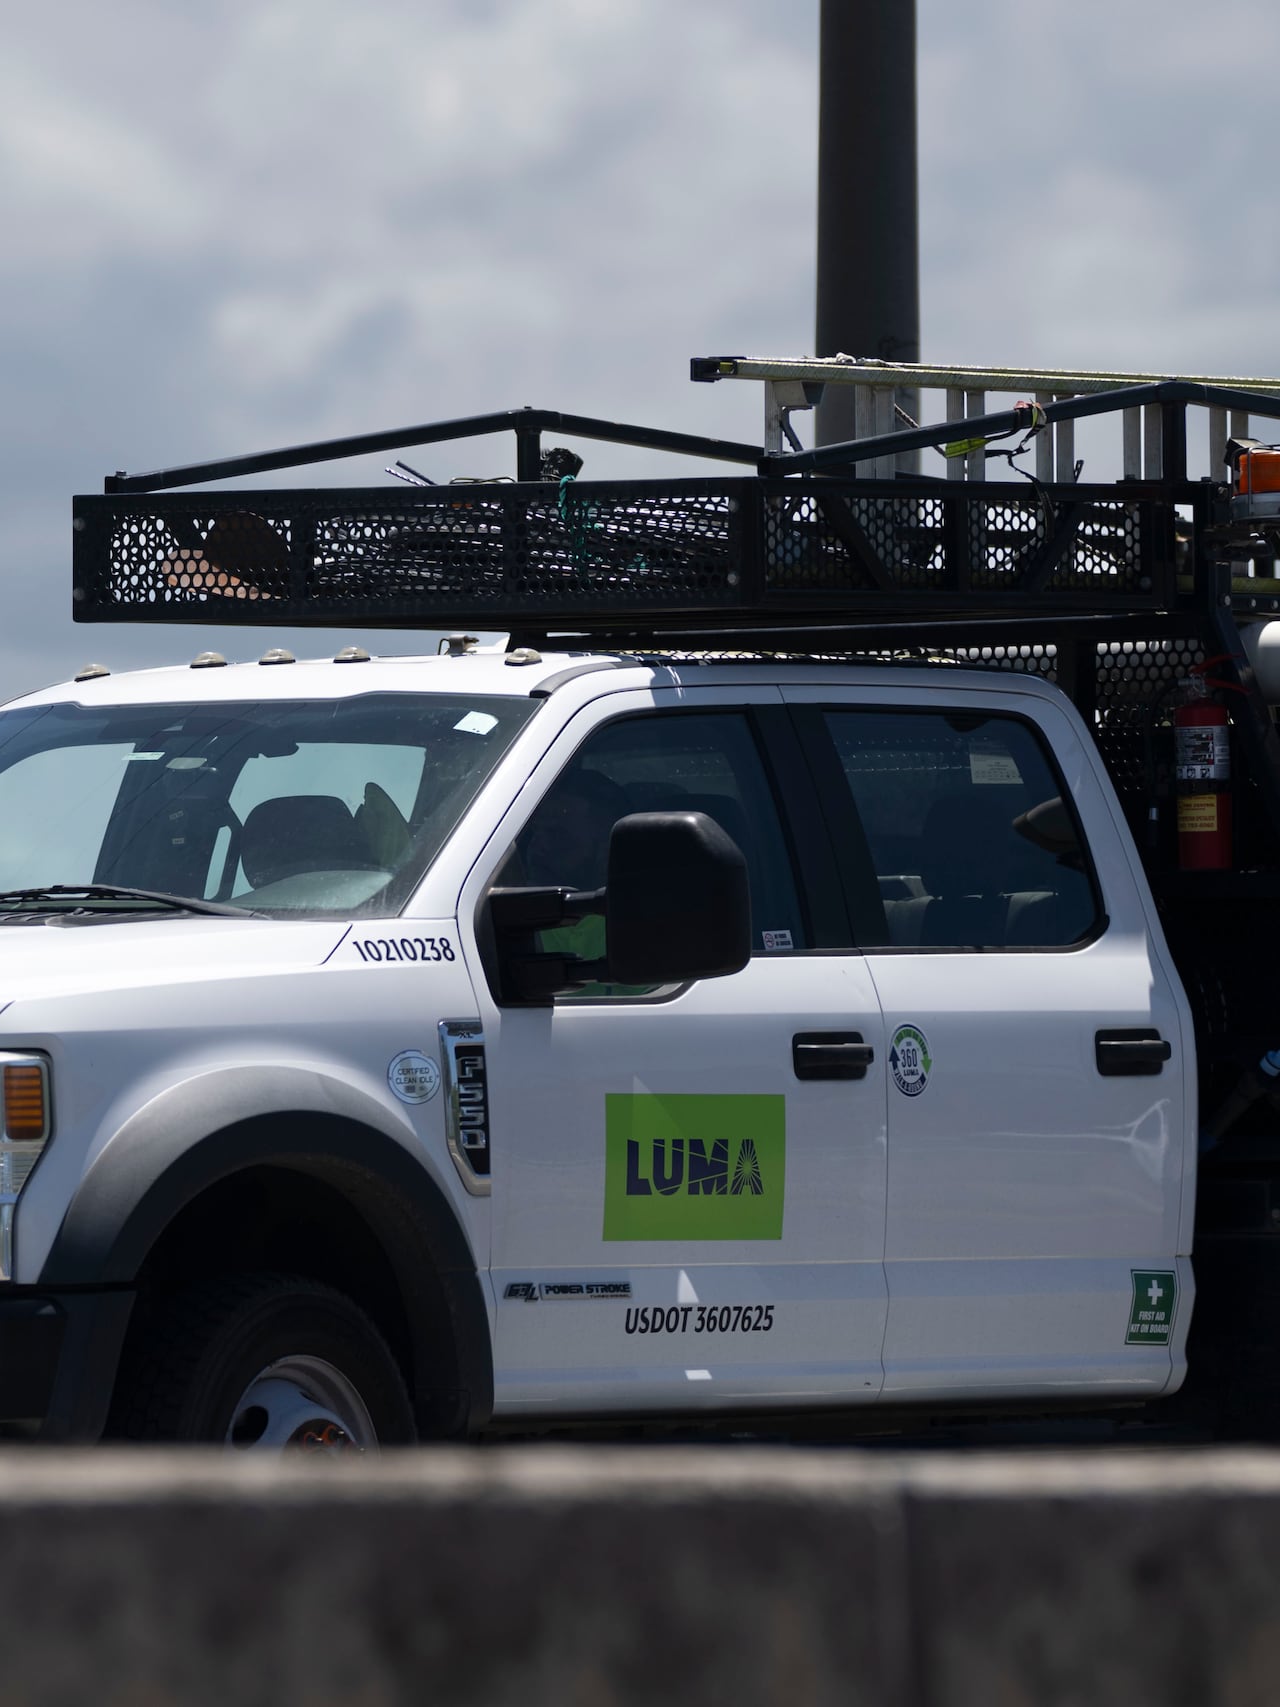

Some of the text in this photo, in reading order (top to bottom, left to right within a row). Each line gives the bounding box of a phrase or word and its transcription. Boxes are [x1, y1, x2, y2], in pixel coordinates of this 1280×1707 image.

[352, 937, 456, 962] 10210238
[397, 1066, 430, 1076] CERTIFIED
[395, 1077, 417, 1085] CLEAN
[626, 1138, 764, 1196] LUMA
[545, 1283, 632, 1295] POWER STROKE
[625, 1305, 775, 1334] USDOT 3607625
[1138, 1311, 1166, 1321] FIRST AID
